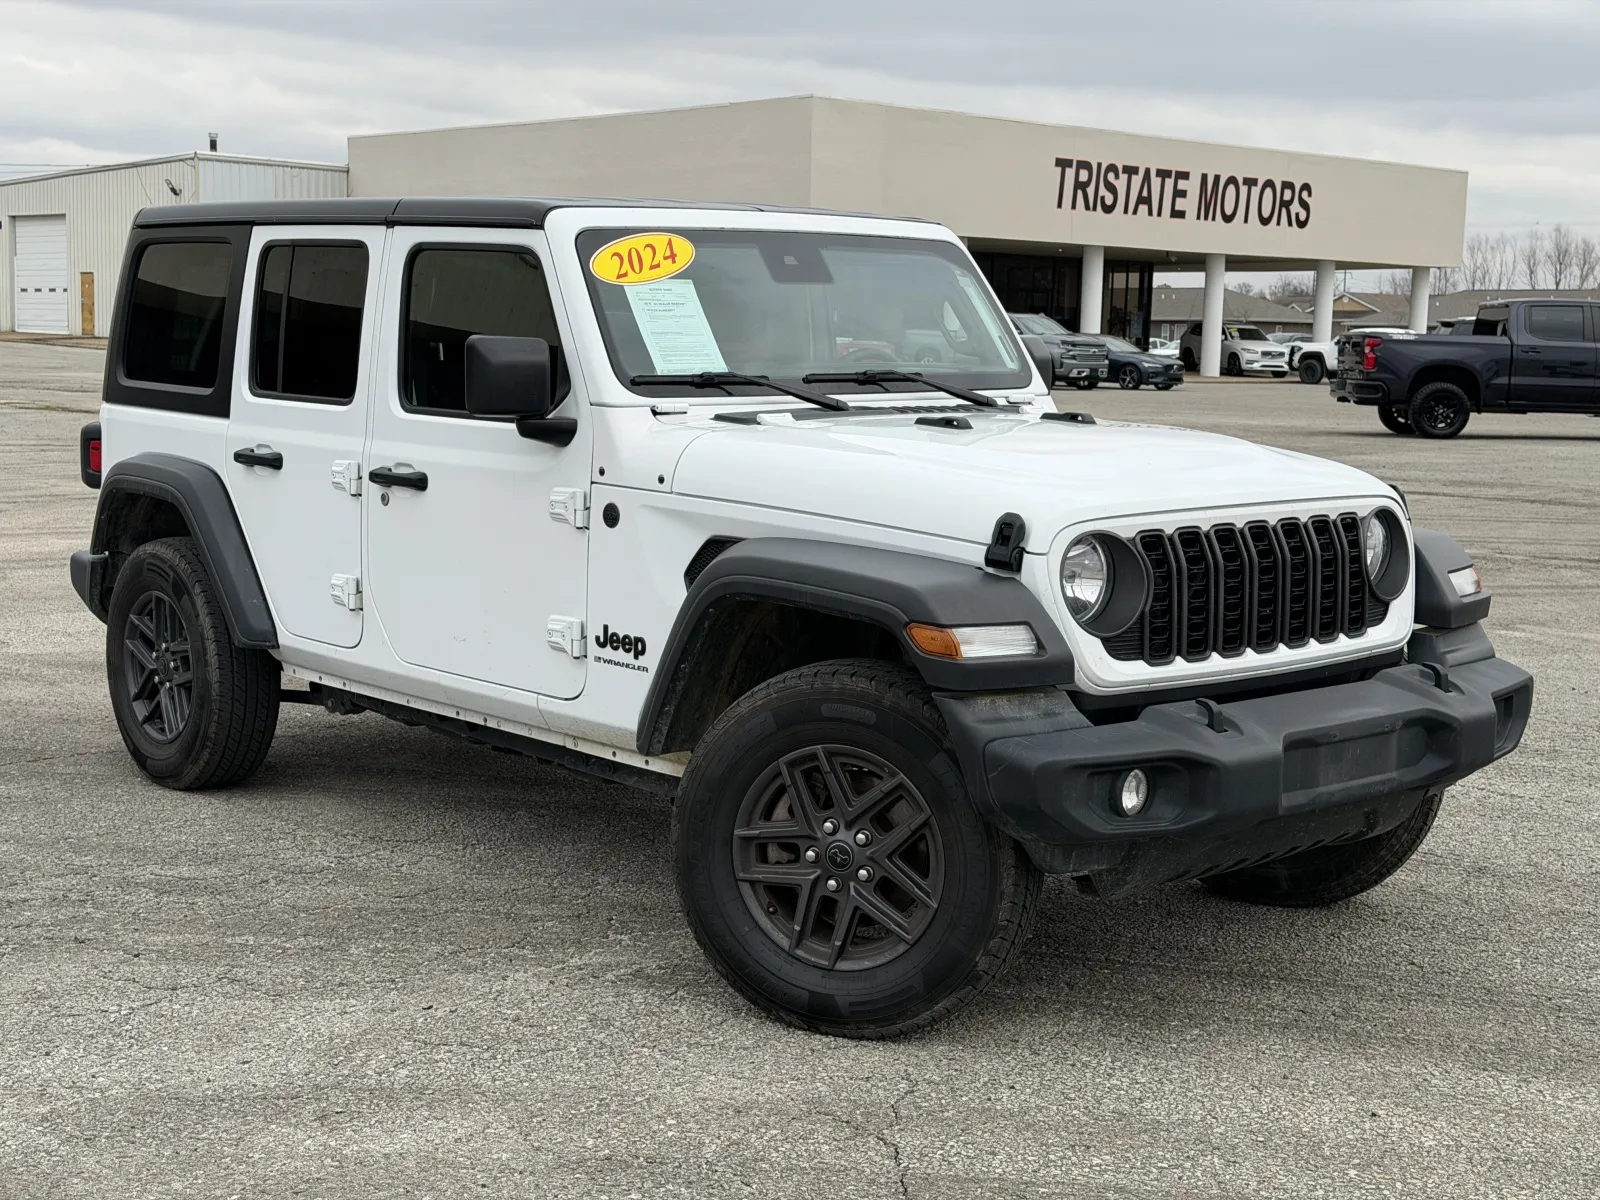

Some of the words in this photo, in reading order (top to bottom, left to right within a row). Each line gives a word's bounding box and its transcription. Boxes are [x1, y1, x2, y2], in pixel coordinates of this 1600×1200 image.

[1054, 157, 1191, 220] TRISTATE
[1196, 172, 1313, 230] MOTORS
[610, 237, 678, 280] 2024
[594, 623, 647, 661] Jeep
[601, 657, 649, 673] WRANGLER
